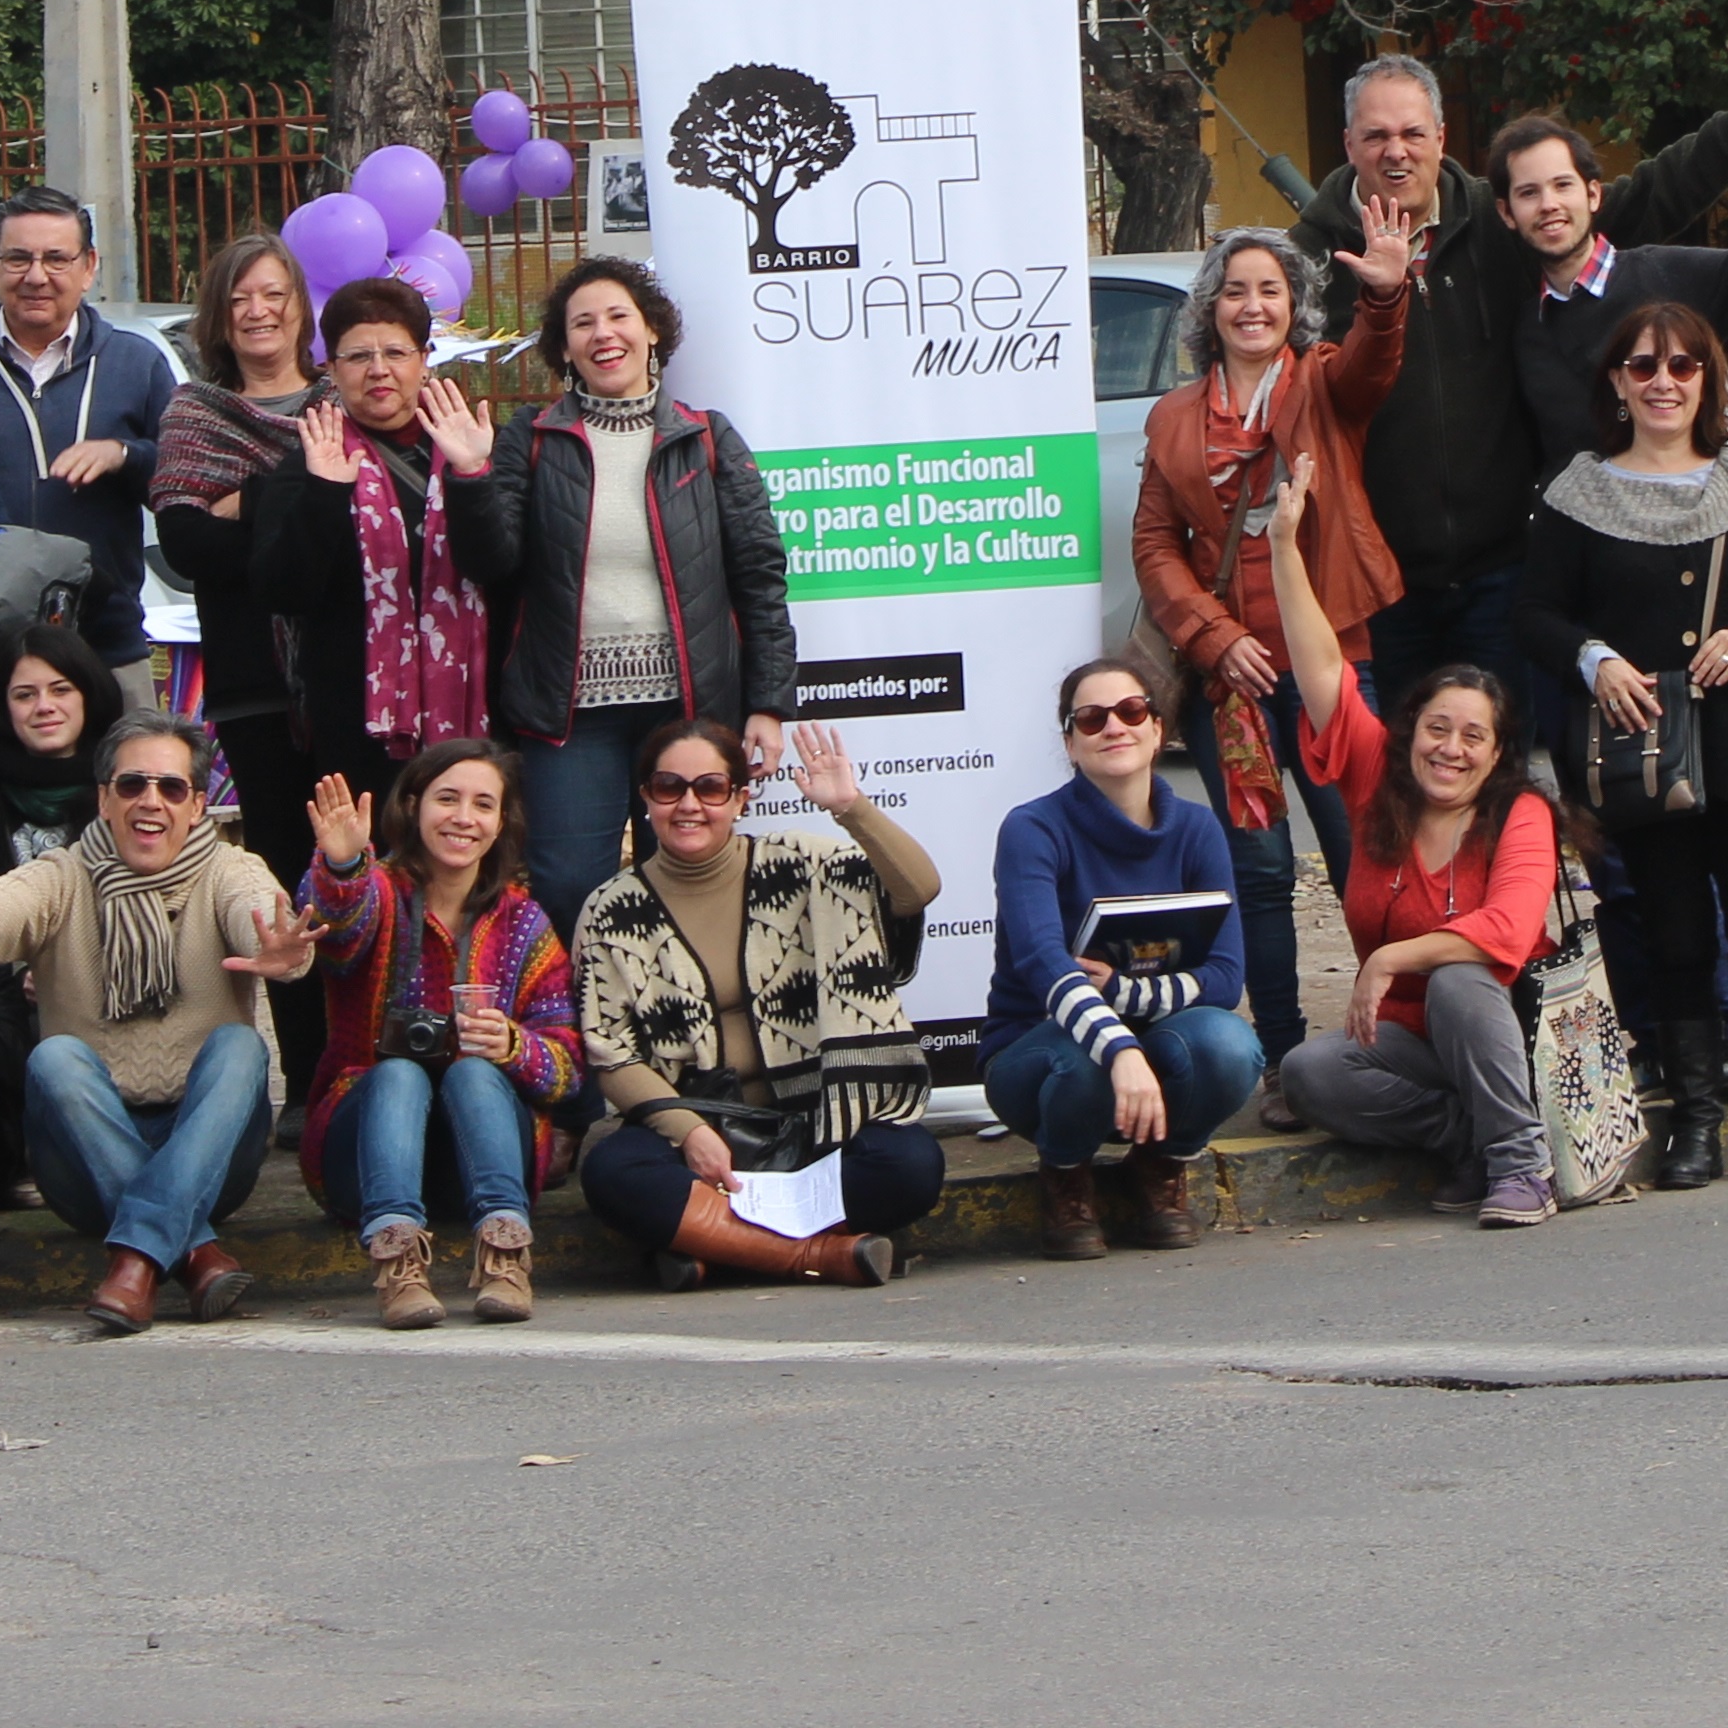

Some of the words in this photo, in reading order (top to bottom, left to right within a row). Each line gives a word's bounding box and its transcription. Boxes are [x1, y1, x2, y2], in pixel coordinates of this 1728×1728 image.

[755, 249, 851, 270] BARRIO
[912, 332, 1061, 379] MUJICA
[896, 445, 1035, 486] Funcional
[813, 503, 879, 539] para
[885, 494, 912, 528] el
[917, 486, 1062, 527] Desarrollo
[784, 536, 917, 576] trimonio
[921, 542, 939, 576] y
[943, 533, 971, 566] la
[975, 528, 1080, 564] Cultura
[795, 674, 906, 707] prometidos
[909, 676, 949, 700] por:
[858, 760, 869, 782] y
[873, 747, 995, 776] conservación
